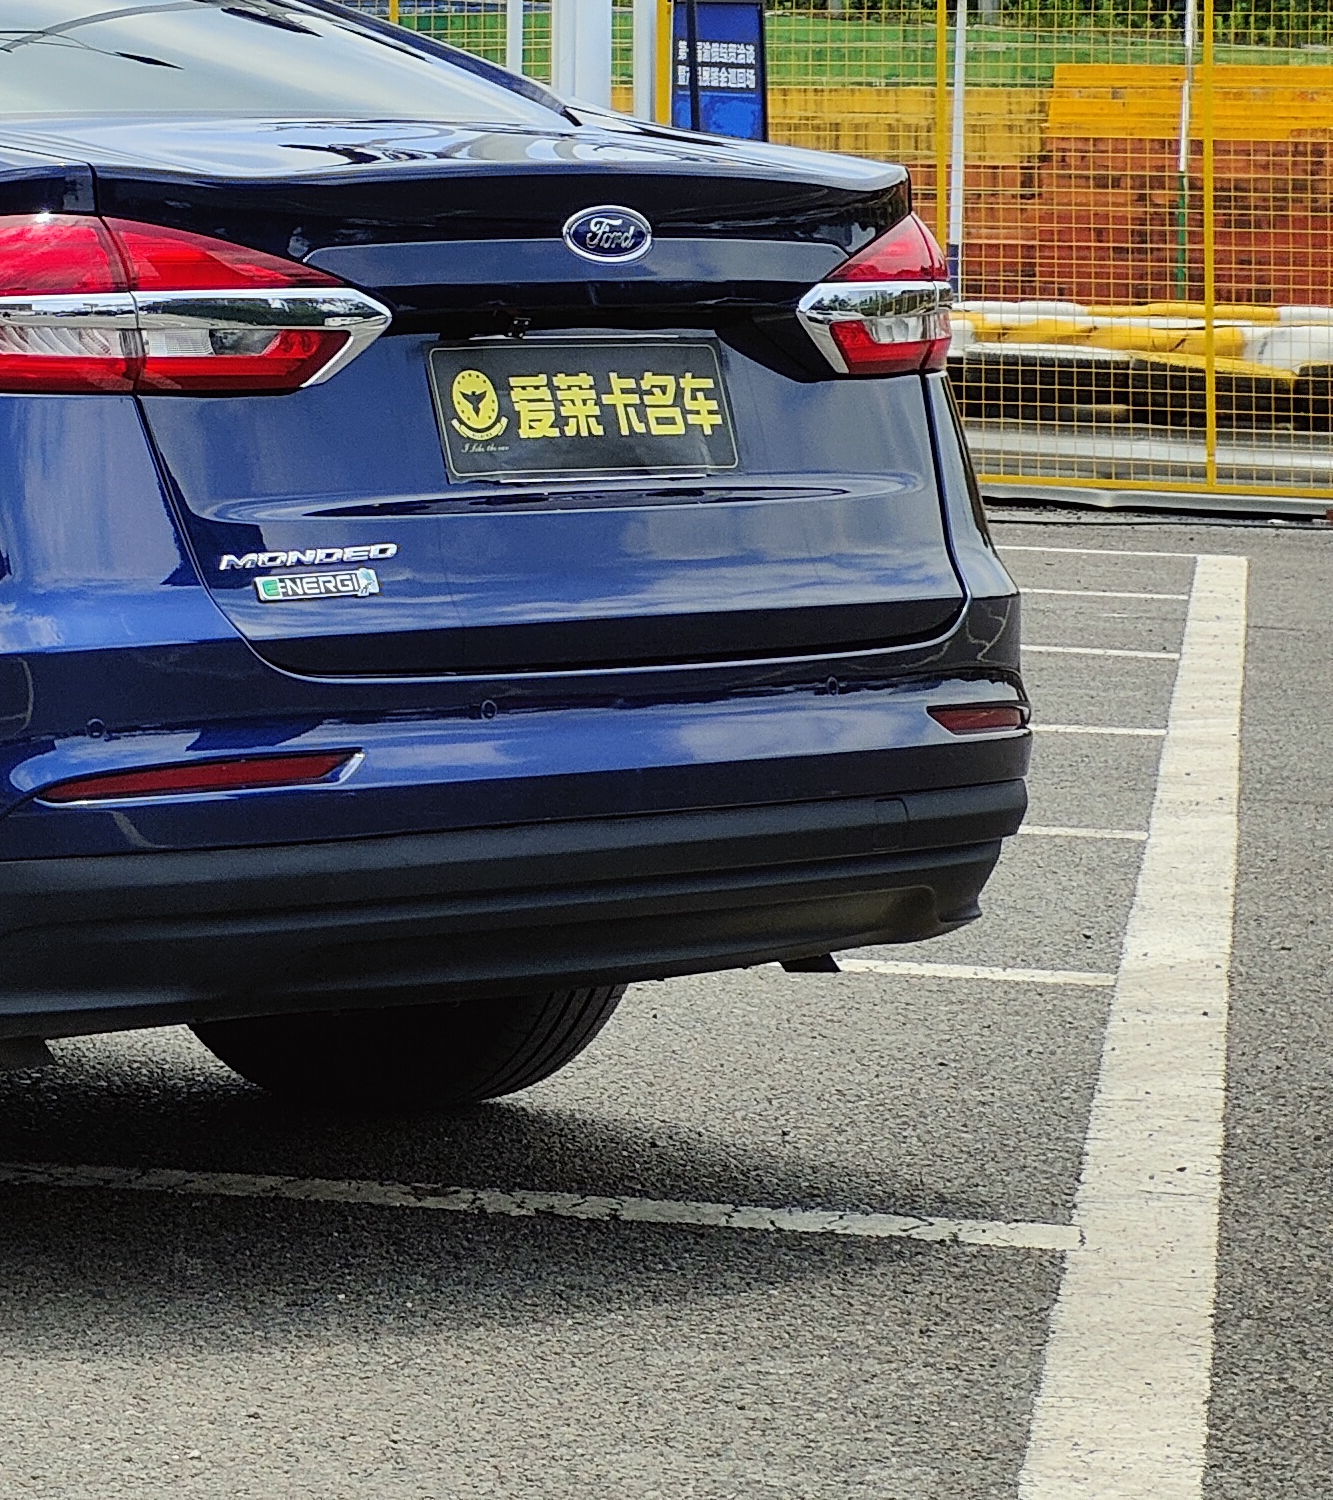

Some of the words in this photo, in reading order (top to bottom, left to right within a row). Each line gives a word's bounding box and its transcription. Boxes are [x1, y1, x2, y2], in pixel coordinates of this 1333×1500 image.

[585, 217, 636, 249] Ford
[508, 371, 723, 439] 爱莱卡名车
[219, 543, 398, 570] MONDEO
